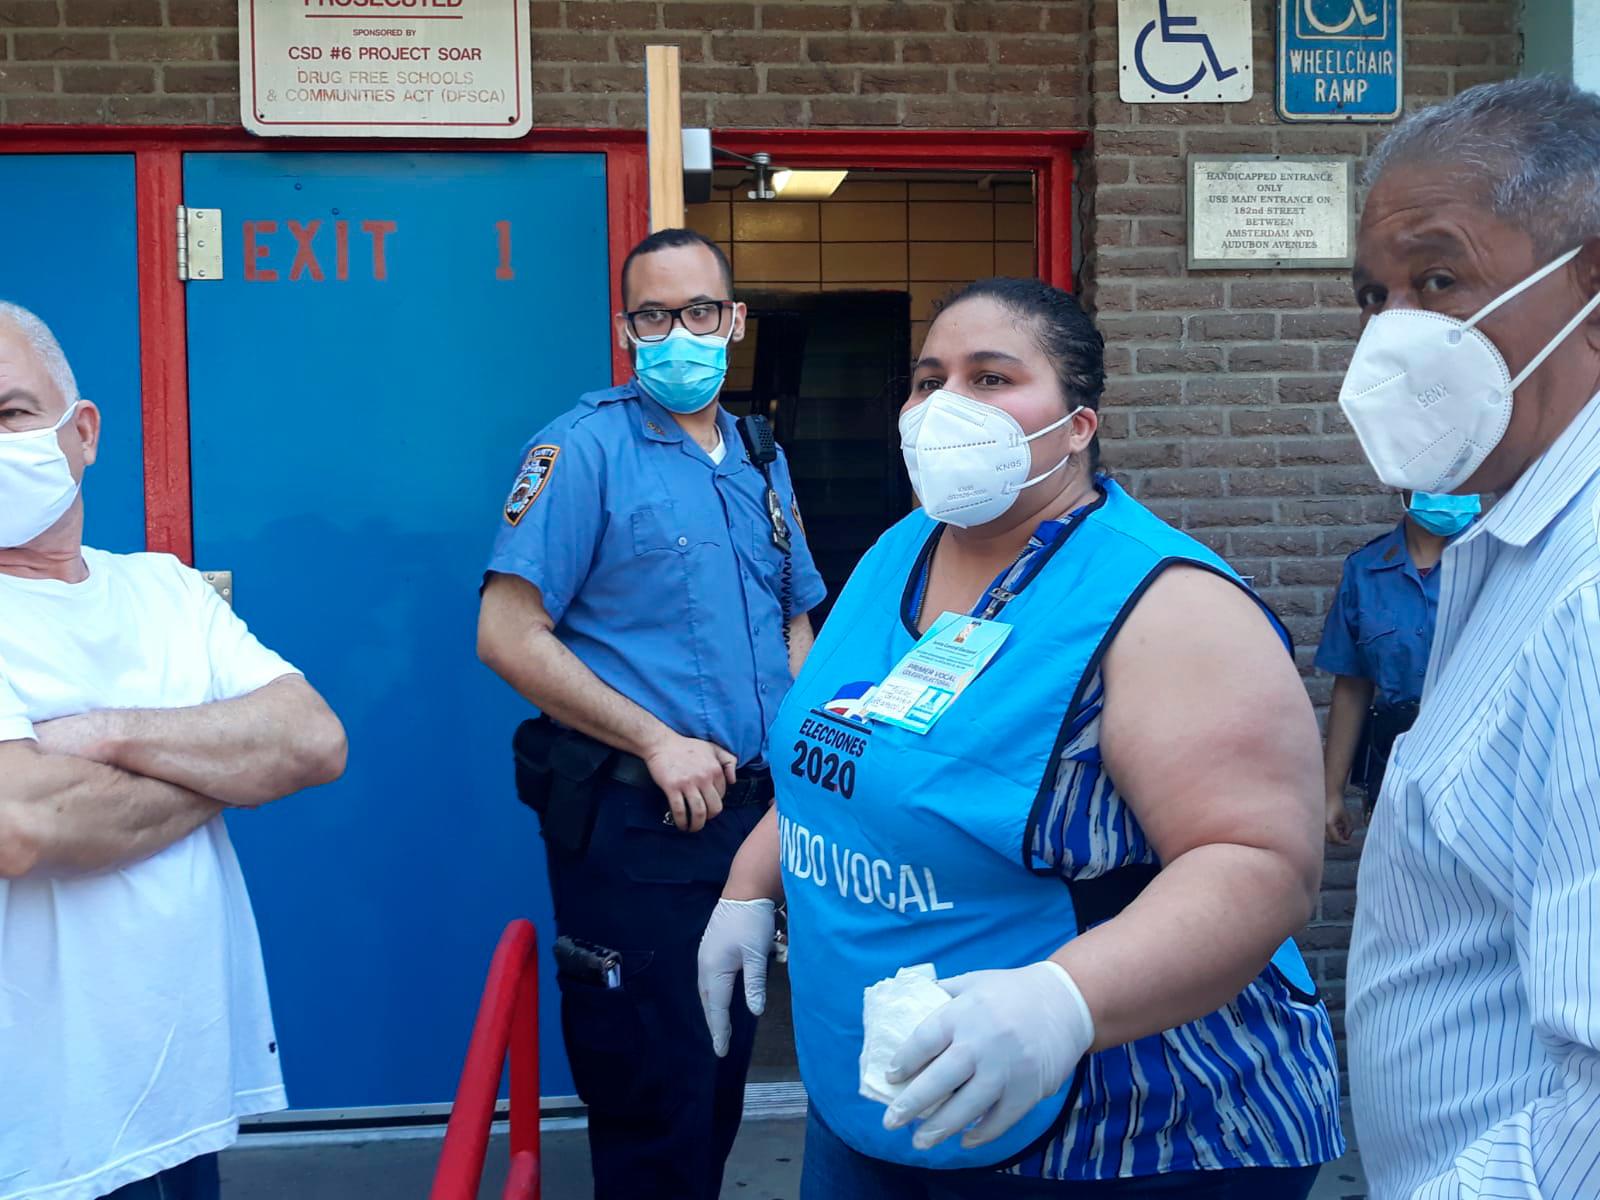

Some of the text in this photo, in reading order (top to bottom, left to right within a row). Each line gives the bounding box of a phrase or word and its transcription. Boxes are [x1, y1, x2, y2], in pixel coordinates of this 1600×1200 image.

[405, 29, 417, 37] BY
[288, 46, 482, 61] CSD #6 PROJECT SOAR
[1290, 49, 1393, 75] WHEELCHAIR
[297, 70, 474, 85] DRUG FREE SCHOOLS
[266, 88, 506, 104] & COMMUNITIES ACT (DFSCA)
[1315, 79, 1368, 103] RAMP
[1206, 172, 1334, 182] HANDICAPPED ENTRANCE
[1256, 184, 1284, 193] ONLY
[1208, 195, 1331, 204] USE MAIN ENTRANCE ON
[1234, 206, 1306, 215] 182nd STREET
[1245, 218, 1294, 226] BETWEEN
[1225, 229, 1314, 238] AMSTERDAM AND
[242, 219, 514, 281] EXIT 1
[1221, 240, 1318, 249] AUDUBON AVENUES
[995, 461, 1022, 473] KN95
[799, 718, 867, 758] ELECCIONES
[791, 739, 856, 800] 2020
[831, 842, 954, 914] VOCAL
